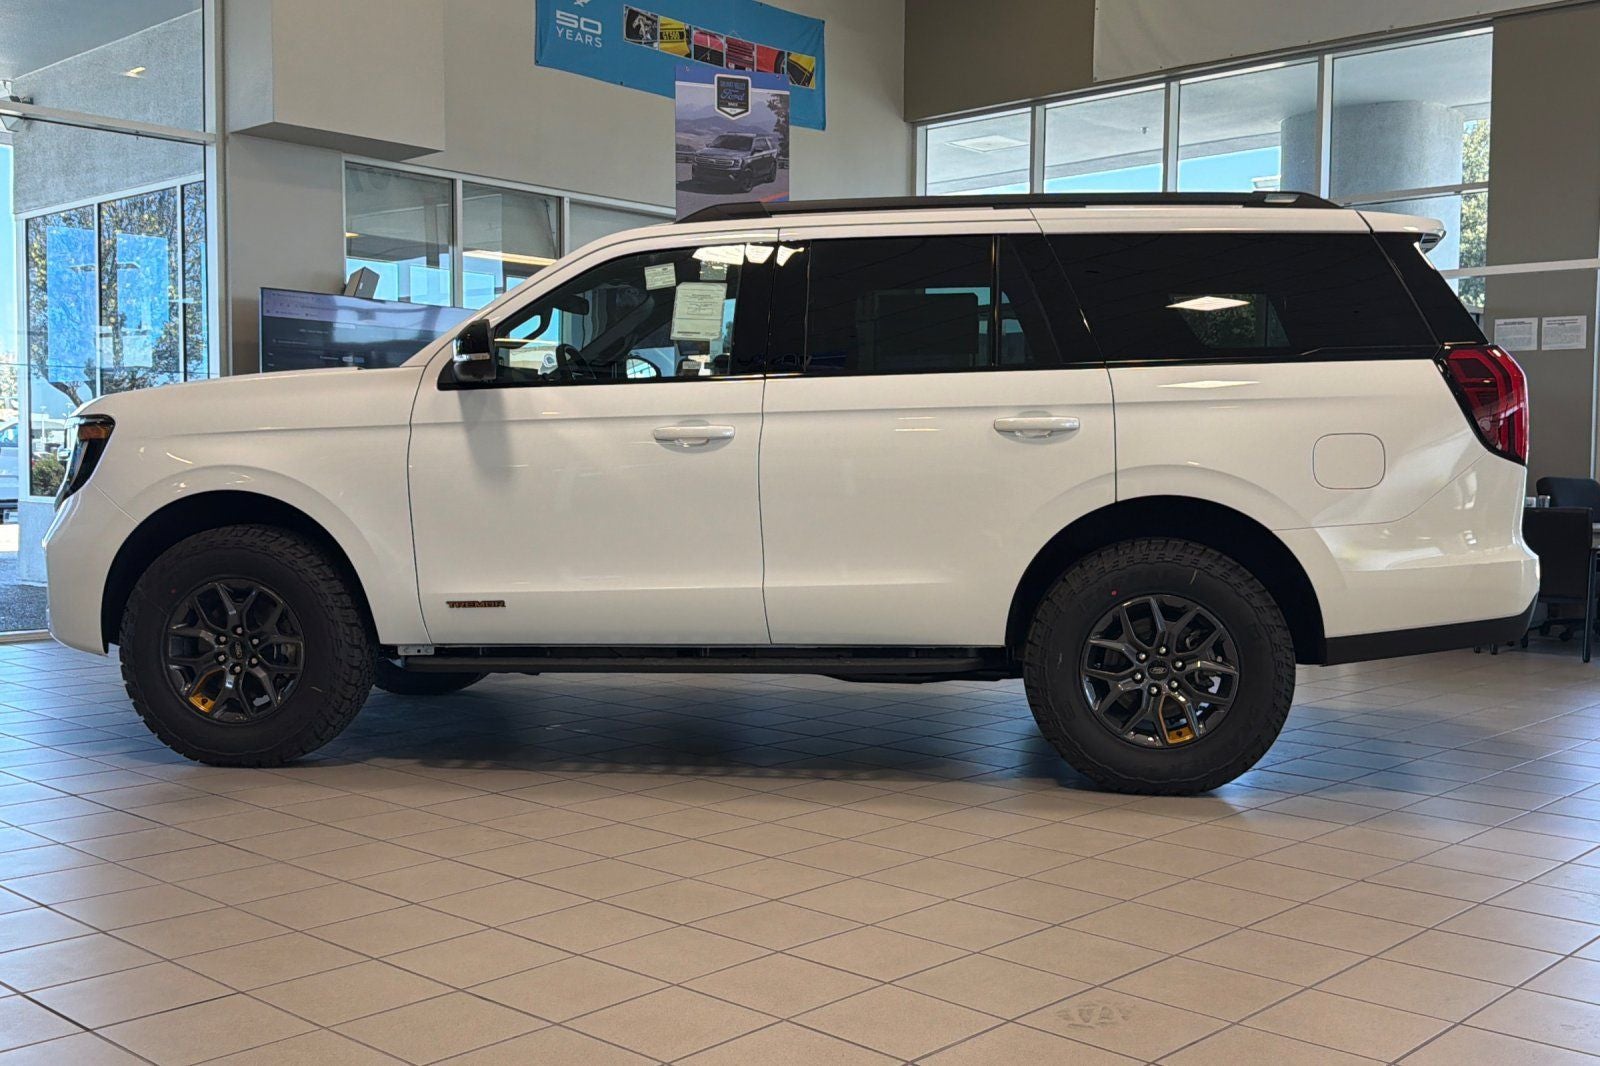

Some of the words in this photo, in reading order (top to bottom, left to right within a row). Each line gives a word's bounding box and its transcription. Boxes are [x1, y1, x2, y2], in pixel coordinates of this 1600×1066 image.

[556, 9, 602, 35] 50
[556, 25, 602, 48] YEARS
[445, 600, 507, 608] TREMOR
